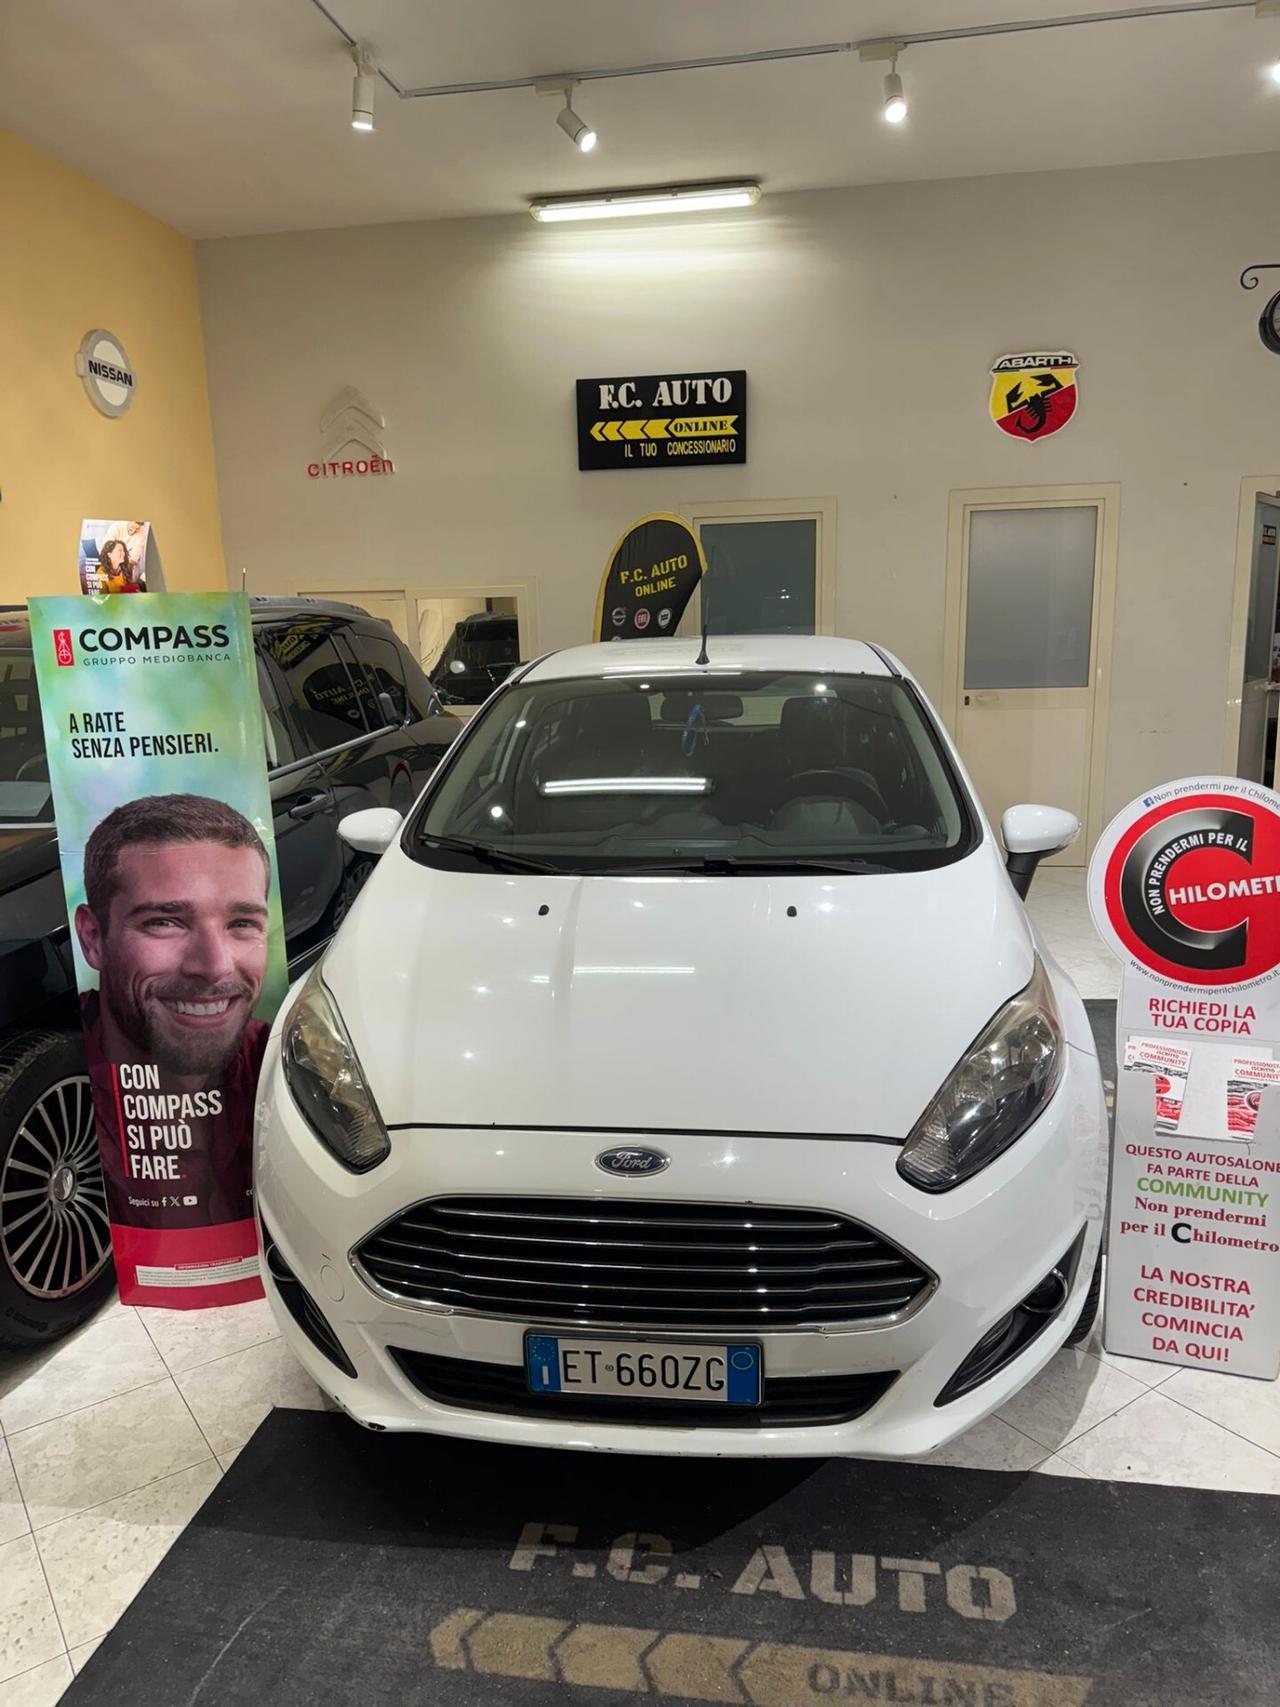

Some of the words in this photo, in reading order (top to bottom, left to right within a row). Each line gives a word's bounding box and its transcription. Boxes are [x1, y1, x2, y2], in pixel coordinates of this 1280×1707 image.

[88, 360, 133, 387] NISSAN
[999, 357, 1071, 369] ABARTH
[599, 382, 643, 410] F.C.
[652, 377, 732, 407] AUTO
[674, 420, 728, 433] ONLINE
[625, 444, 633, 458] IL
[640, 443, 657, 457] TUO
[667, 439, 736, 455] CONCESSIONARIO
[620, 569, 648, 584] F.C.
[651, 555, 688, 578] AUTO
[635, 577, 676, 597] ONLINE
[79, 625, 230, 652] COMPASS
[83, 657, 136, 666] GRUPPO
[143, 653, 230, 665] MEDIOBANCA
[69, 713, 79, 733] A
[83, 712, 126, 733] RATE
[72, 738, 125, 758] SENZA
[129, 732, 219, 757] PENSIERI.
[1154, 791, 1172, 803] Non
[1174, 782, 1221, 795] prendermi
[1223, 784, 1238, 792] per
[1241, 785, 1247, 793] il
[1208, 832, 1234, 846] PER
[1236, 838, 1248, 852] IL
[1149, 834, 1204, 885] PRENDERMI
[1148, 889, 1166, 915] NON
[1149, 998, 1228, 1017] RICHIEDI
[1234, 1005, 1256, 1020] LA
[1151, 1014, 1188, 1029] TUA
[1194, 1018, 1251, 1035] COPIA
[1140, 1052, 1186, 1066] COMMUNITY
[119, 1064, 160, 1089] CON
[123, 1090, 223, 1120] COMPASS
[127, 1125, 144, 1150] SI
[151, 1119, 192, 1150] PUÒ
[611, 1151, 653, 1168] Ford
[1126, 1144, 1182, 1161] QUESTO
[1147, 1163, 1163, 1175] FA
[1167, 1166, 1210, 1182] PARTE
[1215, 1172, 1259, 1188] DELLA
[128, 1195, 150, 1207] Seguici
[1137, 1177, 1269, 1208] COMMUNITY
[1135, 1197, 1168, 1213] Non
[1173, 1202, 1267, 1227] prendermi
[1120, 1221, 1149, 1234] per
[1153, 1222, 1166, 1237] il
[1171, 1222, 1280, 1253] Chilometro
[1141, 1265, 1164, 1282] LA
[1170, 1270, 1251, 1295] NOSTRA
[1141, 1312, 1243, 1341] COMINCIA
[1152, 1337, 1179, 1354] DA
[1185, 1343, 1229, 1362] QUI!
[508, 1522, 700, 1591] F.C.
[730, 1544, 1019, 1622] AUTO
